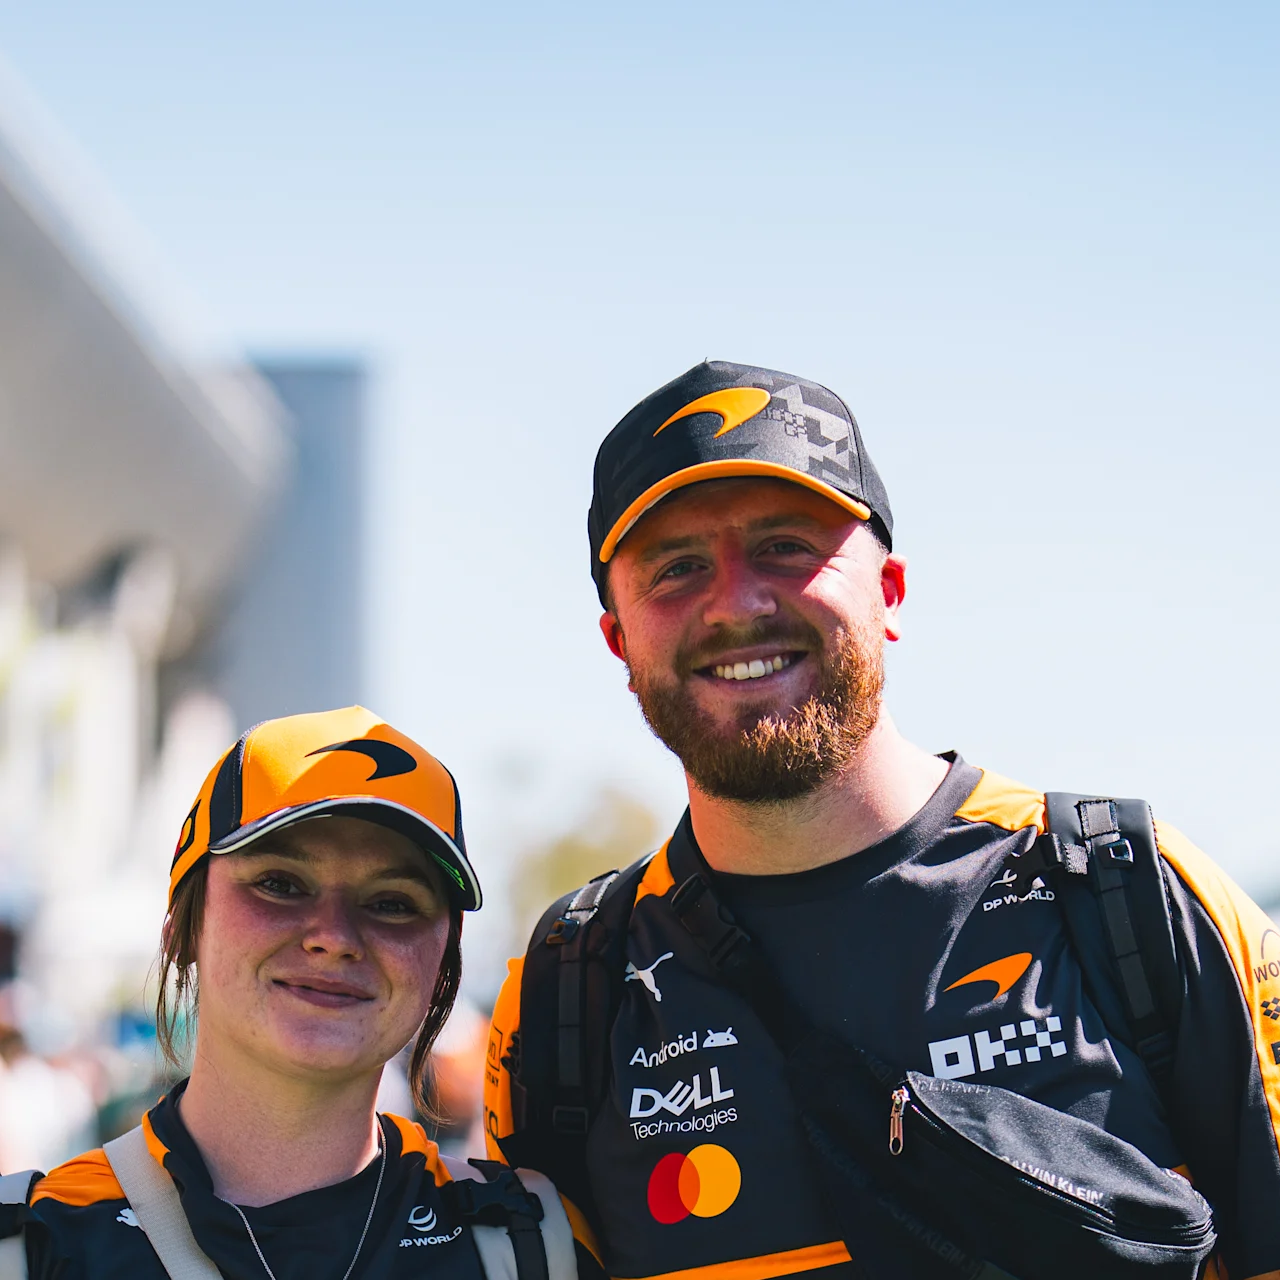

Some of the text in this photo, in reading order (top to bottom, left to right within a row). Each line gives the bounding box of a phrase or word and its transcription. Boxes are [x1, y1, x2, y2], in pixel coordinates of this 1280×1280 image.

[982, 898, 1003, 912] DP
[629, 1030, 699, 1068] Android
[927, 1015, 1068, 1081] OKX
[629, 1065, 735, 1119] DELL
[629, 1106, 738, 1141] Technologies
[1057, 1176, 1105, 1202] KLEIN
[412, 1226, 463, 1247] WORLD
